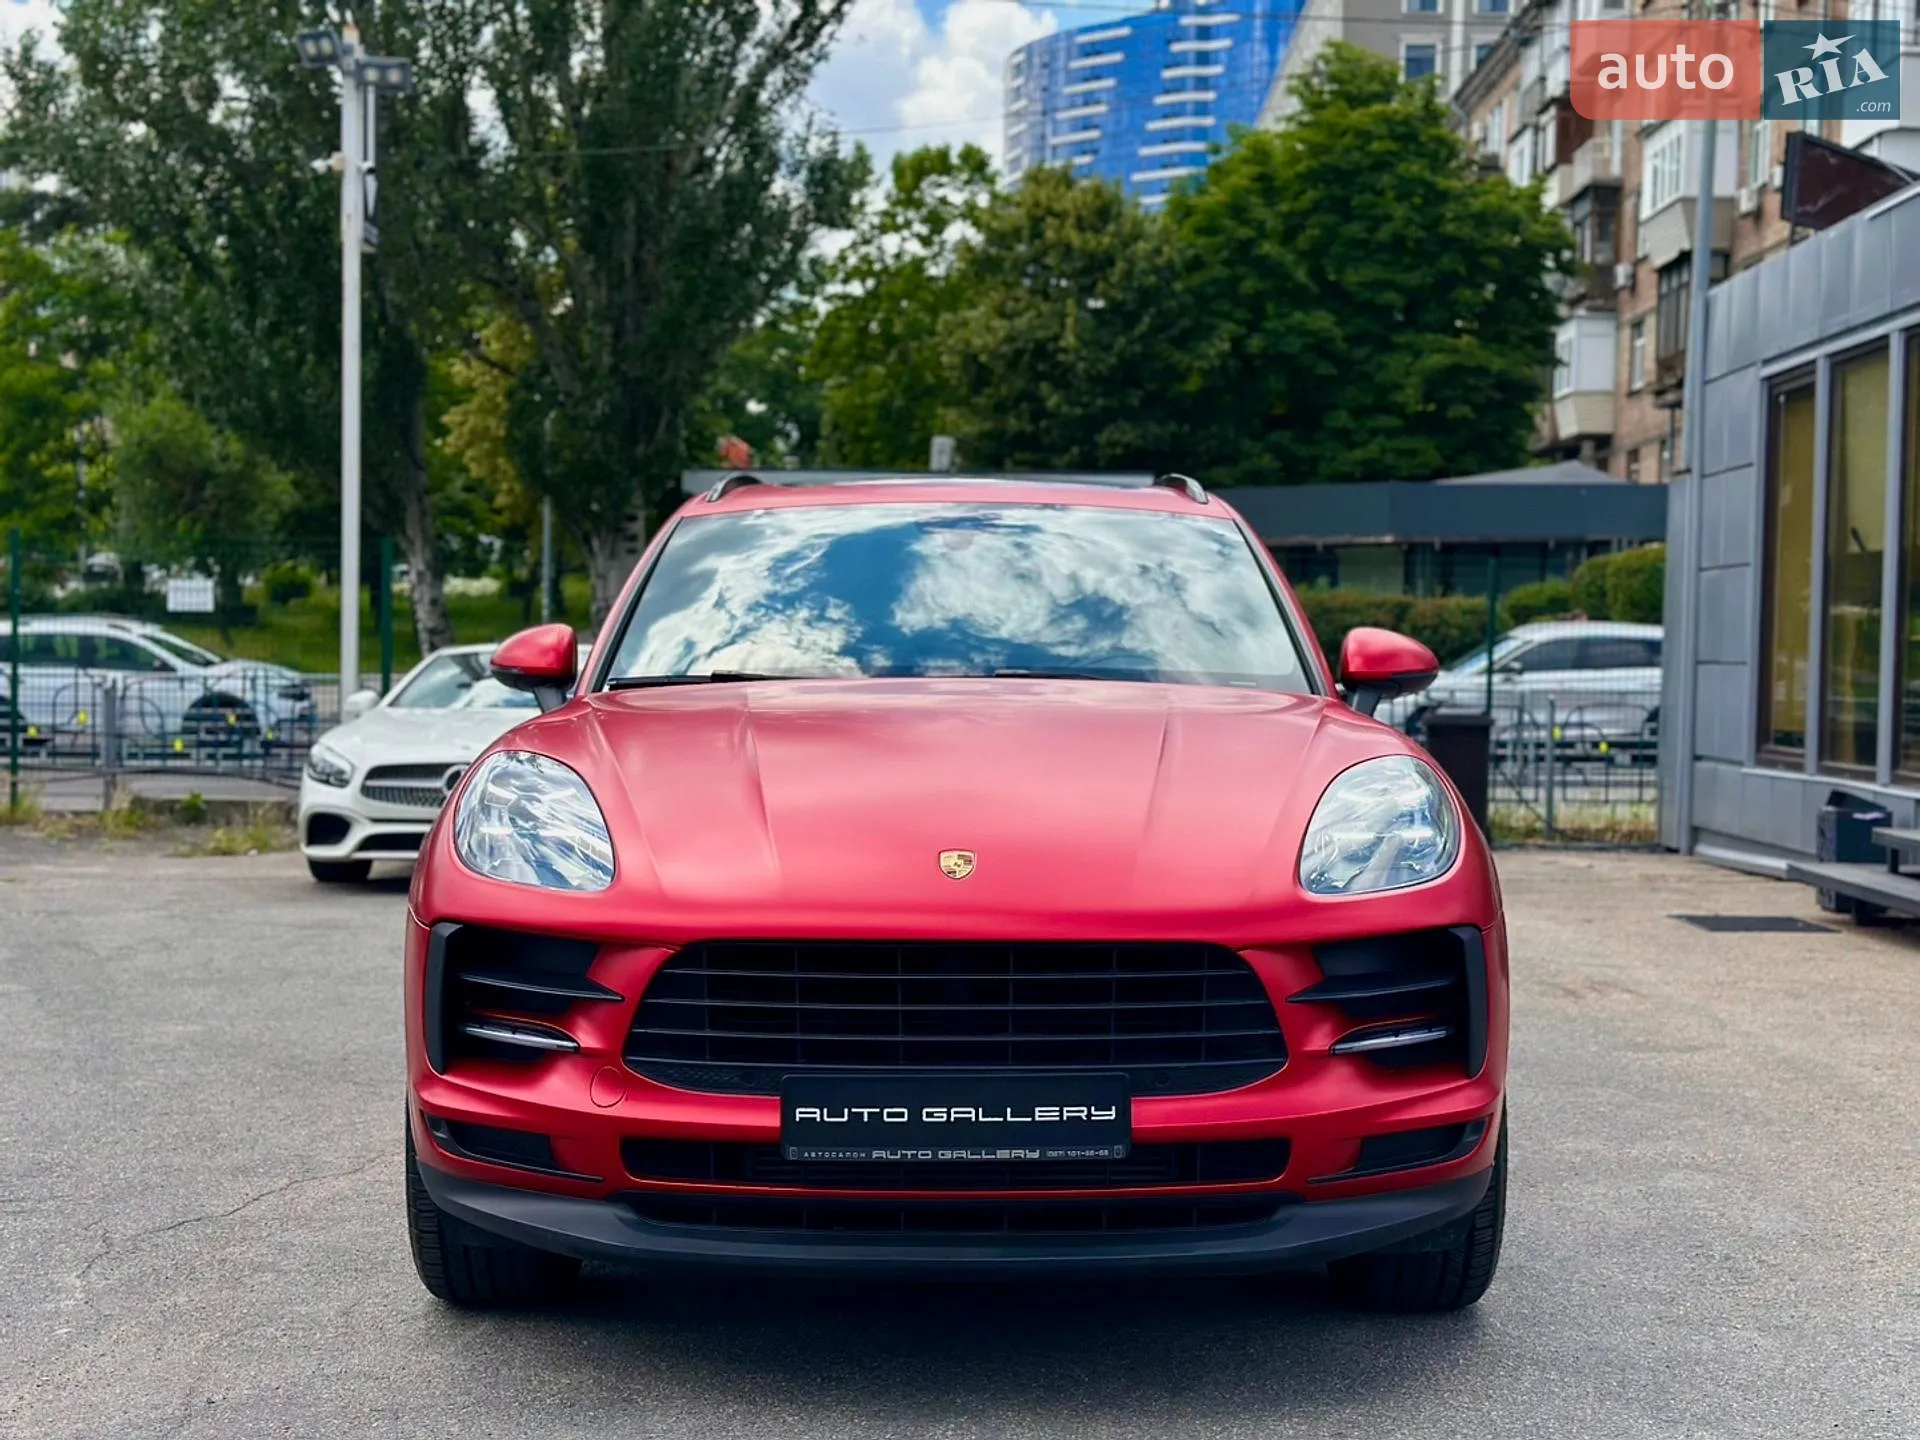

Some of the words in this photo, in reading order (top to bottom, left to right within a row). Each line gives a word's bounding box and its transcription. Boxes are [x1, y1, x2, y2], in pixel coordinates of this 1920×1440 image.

[795, 1107, 908, 1122] AUTO
[922, 1105, 1116, 1121] GALLERY
[872, 1150, 931, 1159] AUTO
[938, 1149, 1040, 1159] GALLERY
